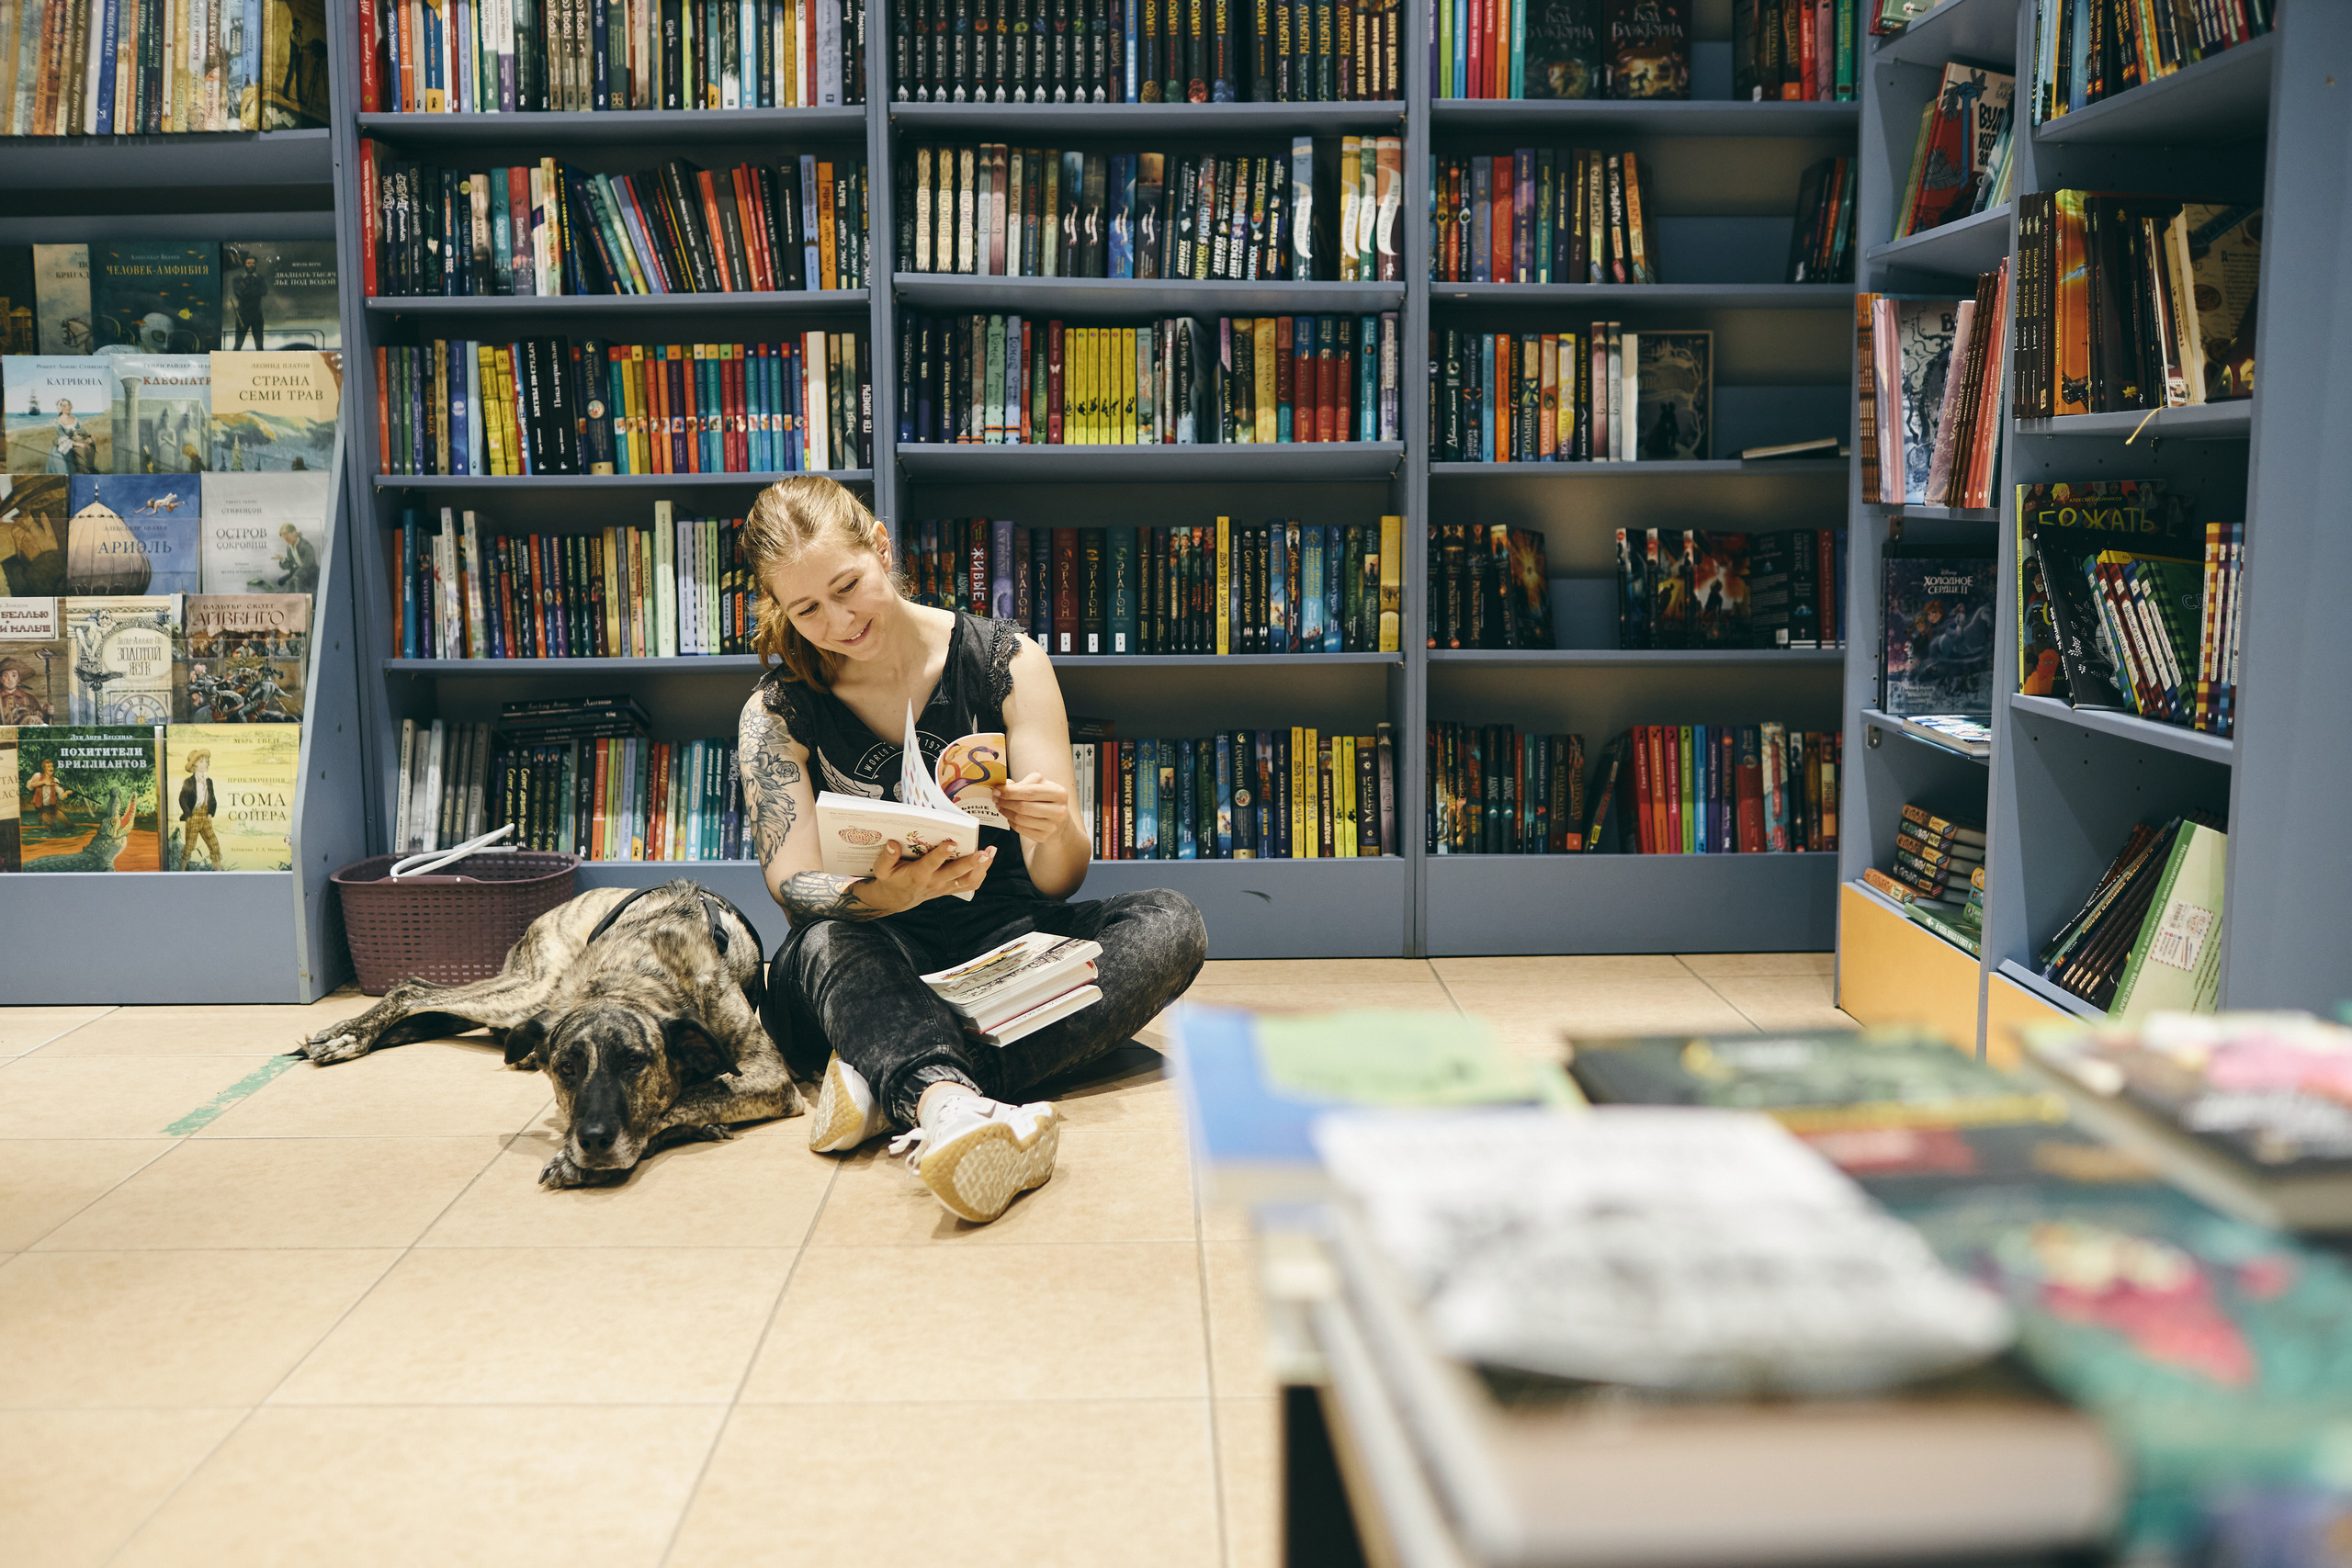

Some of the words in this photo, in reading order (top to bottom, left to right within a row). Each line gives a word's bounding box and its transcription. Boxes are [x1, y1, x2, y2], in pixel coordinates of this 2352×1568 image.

[548, 9, 557, 39] ГОРОД
[562, 9, 571, 39] ГОРОД
[577, 9, 585, 39] ГОРОД
[1388, 12, 1396, 44] ЗАМОК
[208, 24, 216, 55] БЕЛАЯ
[1356, 14, 1366, 68] ХАРАКТЕРОМ
[1386, 46, 1397, 90] ХОДЯЧИЙ
[1356, 76, 1367, 95] ДОМ
[382, 175, 395, 210] КОМПАС
[822, 186, 831, 210] ЯМЫ
[838, 180, 846, 208] ШАГИ
[107, 265, 209, 276] ЧЕЛОВЕК-АМФИБИЯ
[1178, 239, 1187, 276] ХОКИНГ
[1213, 235, 1223, 276] ХОКИНГ
[1228, 238, 1238, 279] ХОКИНГ
[311, 277, 336, 286] ВОДОЙ
[551, 341, 560, 386] нормально
[46, 378, 103, 387] КАТРИОНА
[240, 389, 284, 400] СЕМИ
[289, 389, 323, 400] ТРАВ
[253, 376, 310, 387] СТРАНА
[553, 387, 561, 408] Пока
[862, 384, 872, 416] ХИМЕРЫ
[863, 419, 872, 434] ГЕН
[1523, 407, 1532, 453] БОЛЬШАЯ
[1542, 411, 1551, 454] БОЛЬШАЯ
[98, 541, 172, 554] АРИЭЛЬ
[216, 527, 267, 539] ОСТРОВ
[217, 541, 266, 550] СОКРОВИЩ
[970, 547, 986, 601] ЖИВЫЕ
[1018, 562, 1028, 616] ЭРАГОН
[1088, 562, 1098, 616] ЭРАГОН
[1116, 560, 1126, 616] ЭРАГОН
[1923, 576, 1973, 587] ХОЛОДНОЕ
[1061, 562, 1070, 617] ЭРАГОН
[1928, 586, 1959, 594] СЕРДЦЕ
[10, 625, 51, 633] МАЛЫШ
[193, 609, 284, 626] АЙВЕНГО
[117, 645, 162, 661] ЗОЛОТОЙ
[128, 660, 152, 676] ЖУК
[57, 759, 147, 769] БРИЛЛИАНТОВ
[60, 747, 143, 758] ПОХИТИТЕЛИ
[1236, 745, 1245, 788] САМАРСКИЙ
[228, 792, 286, 807] ТОМА
[1125, 773, 1133, 805] ЗАМОК
[228, 809, 287, 821] СОЙЕРА
[1323, 799, 1331, 844] ВОЗДУШНЫЙ
[2117, 966, 2138, 1016] MINECRAFT
